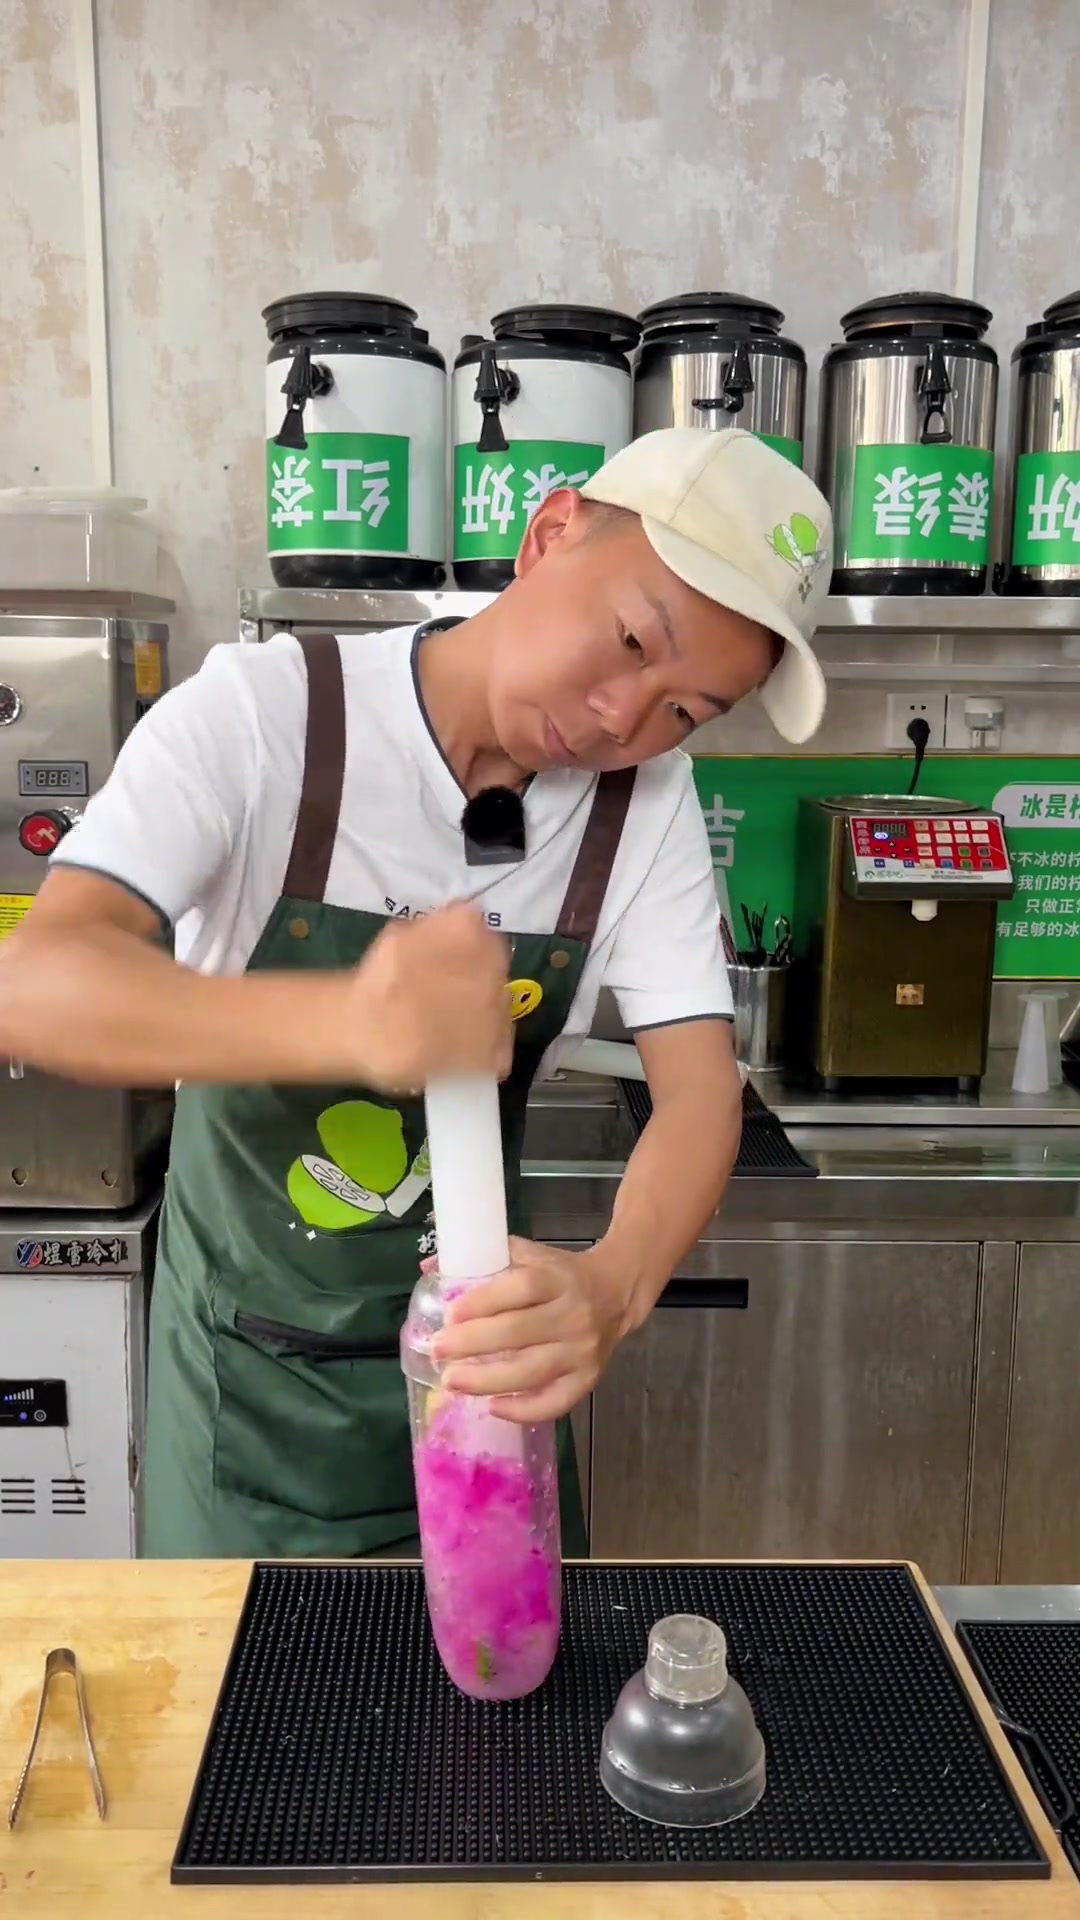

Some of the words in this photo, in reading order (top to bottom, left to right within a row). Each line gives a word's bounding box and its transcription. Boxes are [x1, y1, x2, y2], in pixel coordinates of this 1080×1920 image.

[270, 455, 391, 529] 红茶
[872, 466, 990, 541] 泰绿
[1017, 874, 1080, 892] 我们的柠
[1025, 898, 1080, 915] 只做正
[996, 921, 1080, 938] 有足够的冰
